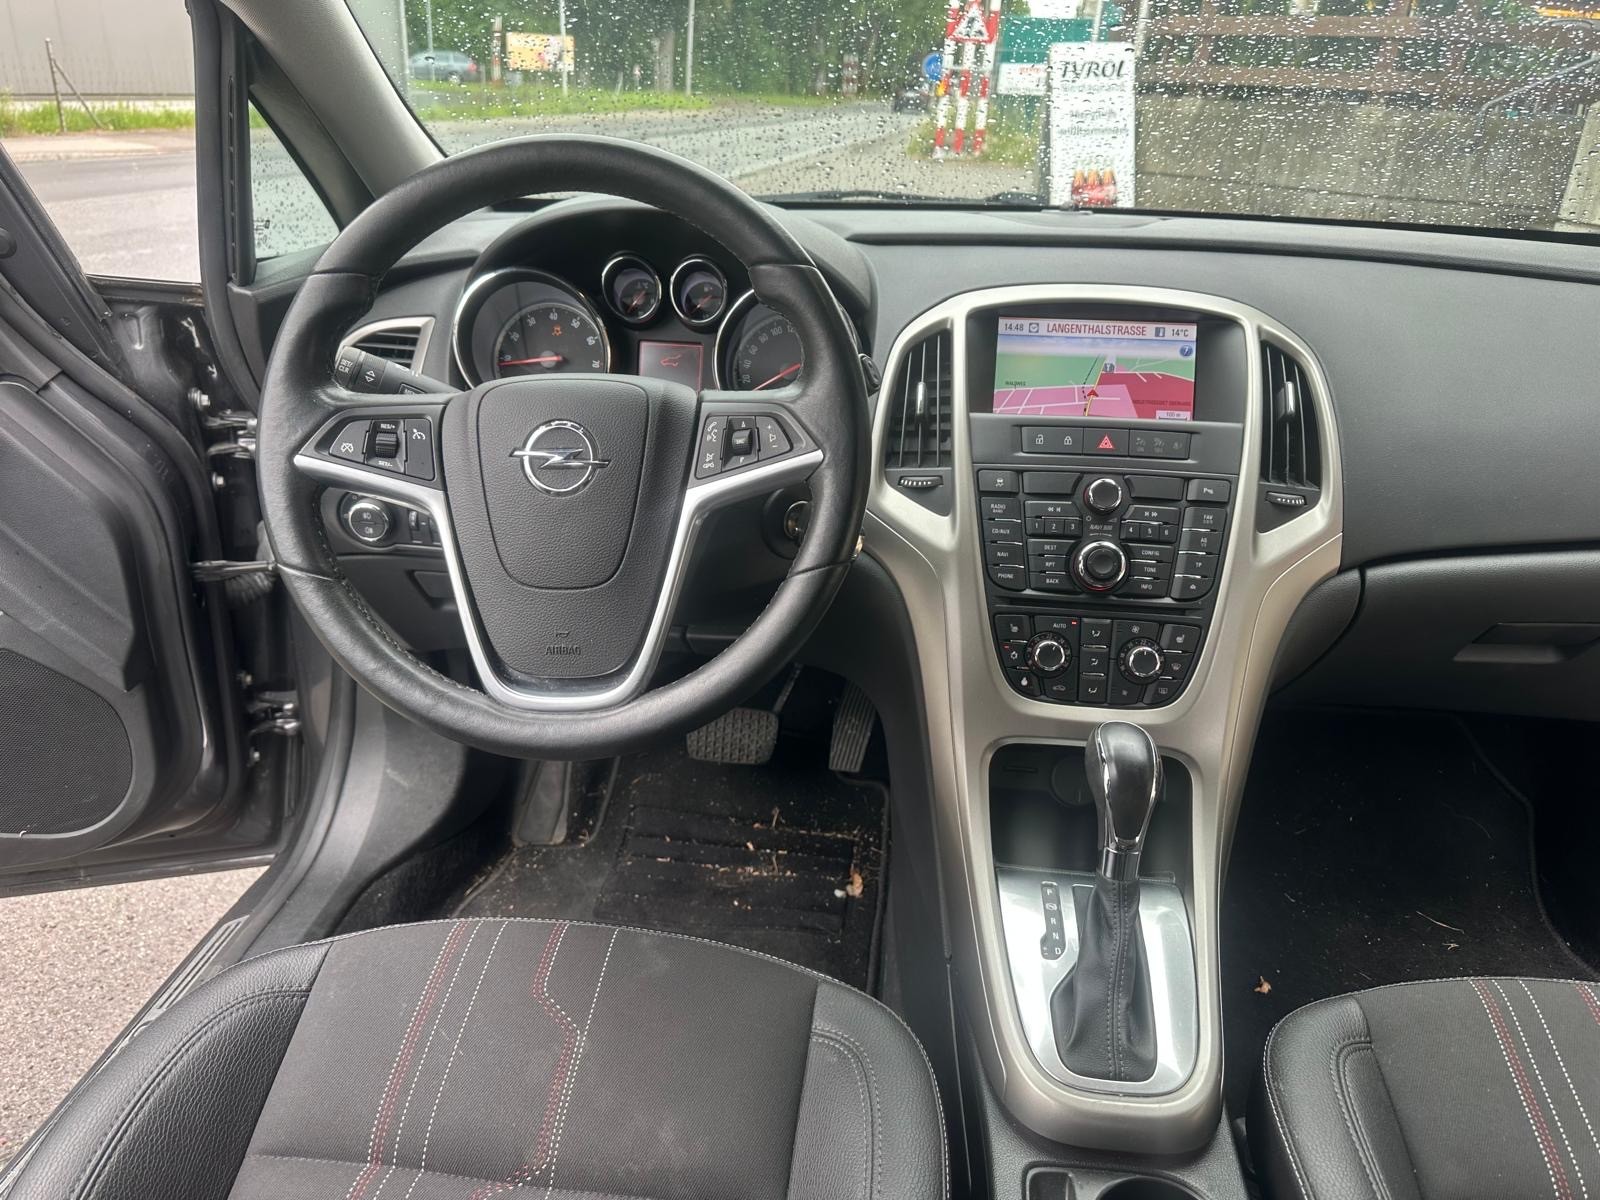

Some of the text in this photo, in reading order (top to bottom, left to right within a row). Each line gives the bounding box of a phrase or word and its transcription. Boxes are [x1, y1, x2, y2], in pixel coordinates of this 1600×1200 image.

[1046, 323, 1147, 337] LANGENTHALSTRASSE
[1171, 328, 1189, 338] 14°C
[997, 572, 1014, 580] PHONE
[1055, 947, 1061, 955] D
